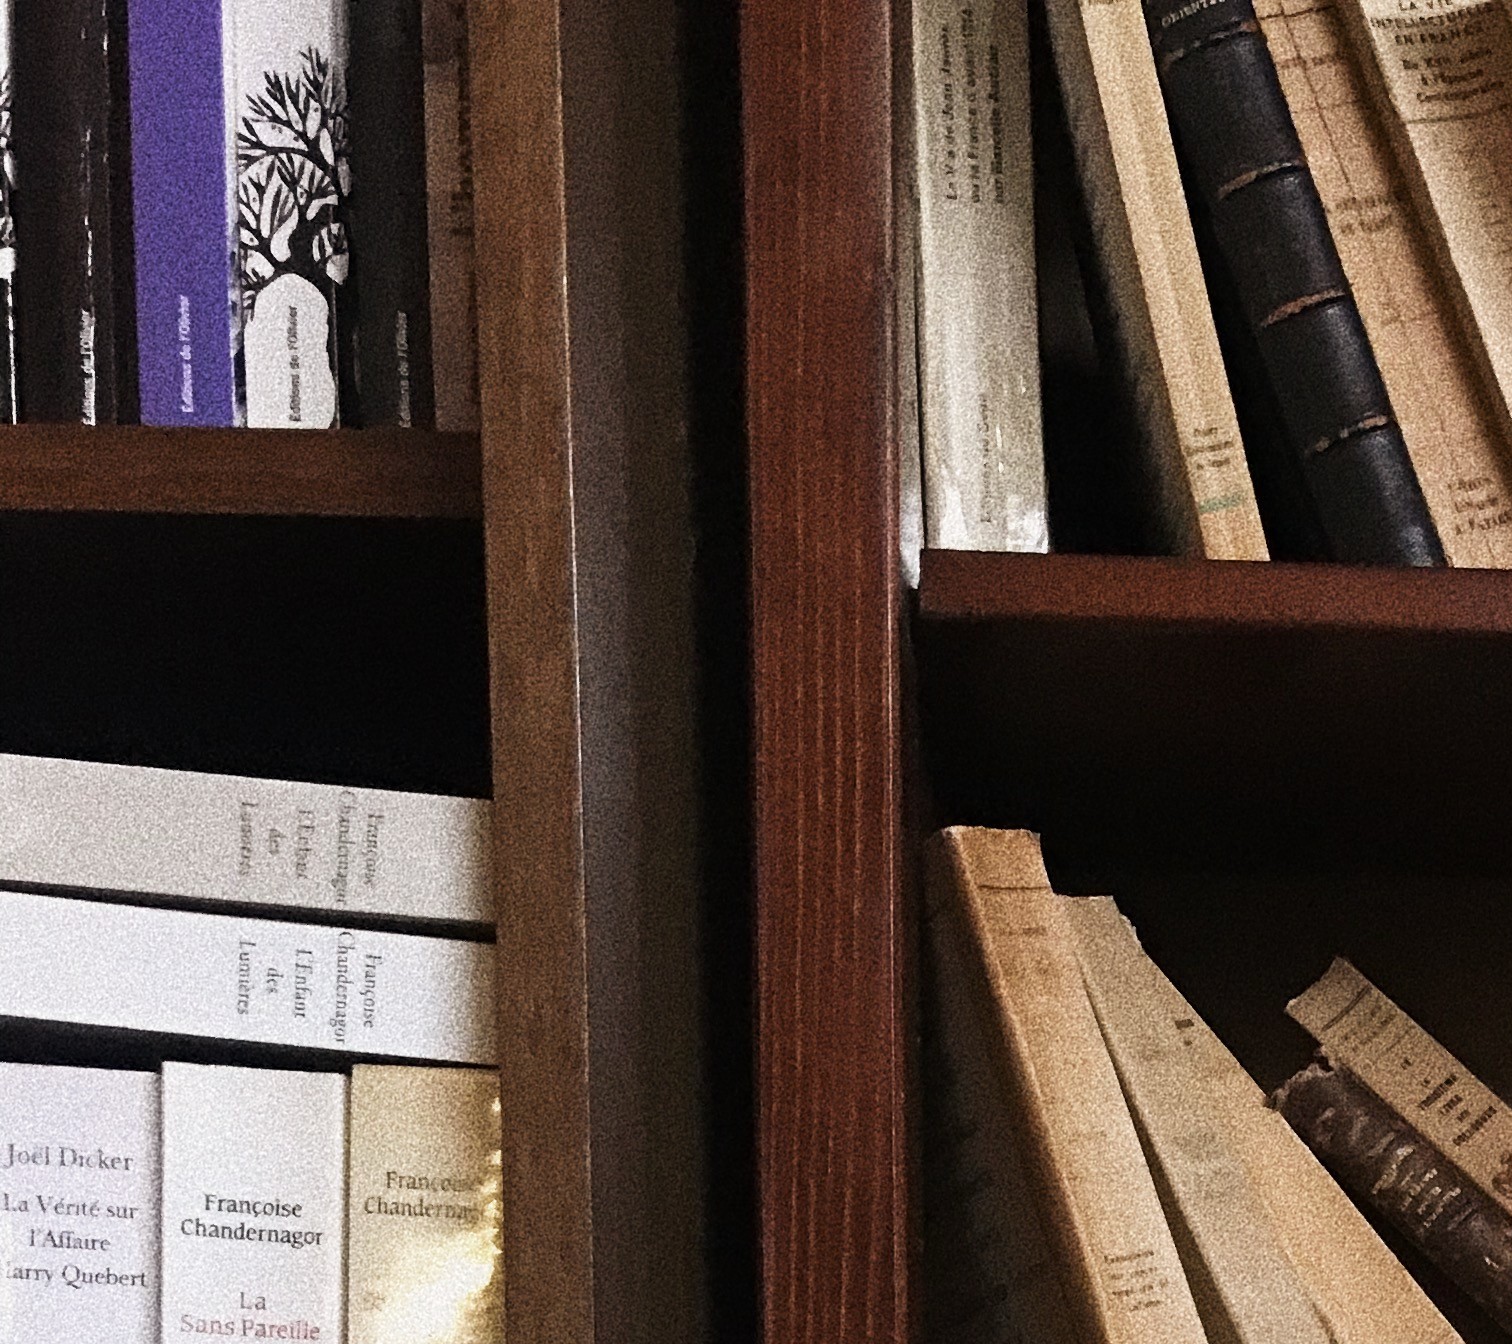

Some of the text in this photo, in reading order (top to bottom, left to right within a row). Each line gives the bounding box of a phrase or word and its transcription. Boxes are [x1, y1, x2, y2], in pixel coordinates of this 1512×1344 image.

[328, 931, 356, 1044] Chandernagor
[359, 953, 382, 1028] Françoise
[59, 1145, 134, 1172] Dicker
[36, 1194, 99, 1217] Vérité
[106, 1203, 138, 1221] sur
[203, 1194, 303, 1219] Françoise
[179, 1218, 324, 1250] Chandernagor
[61, 1263, 147, 1289] Quebert
[239, 1291, 266, 1311] La
[179, 1314, 321, 1341] Sans Pareille
